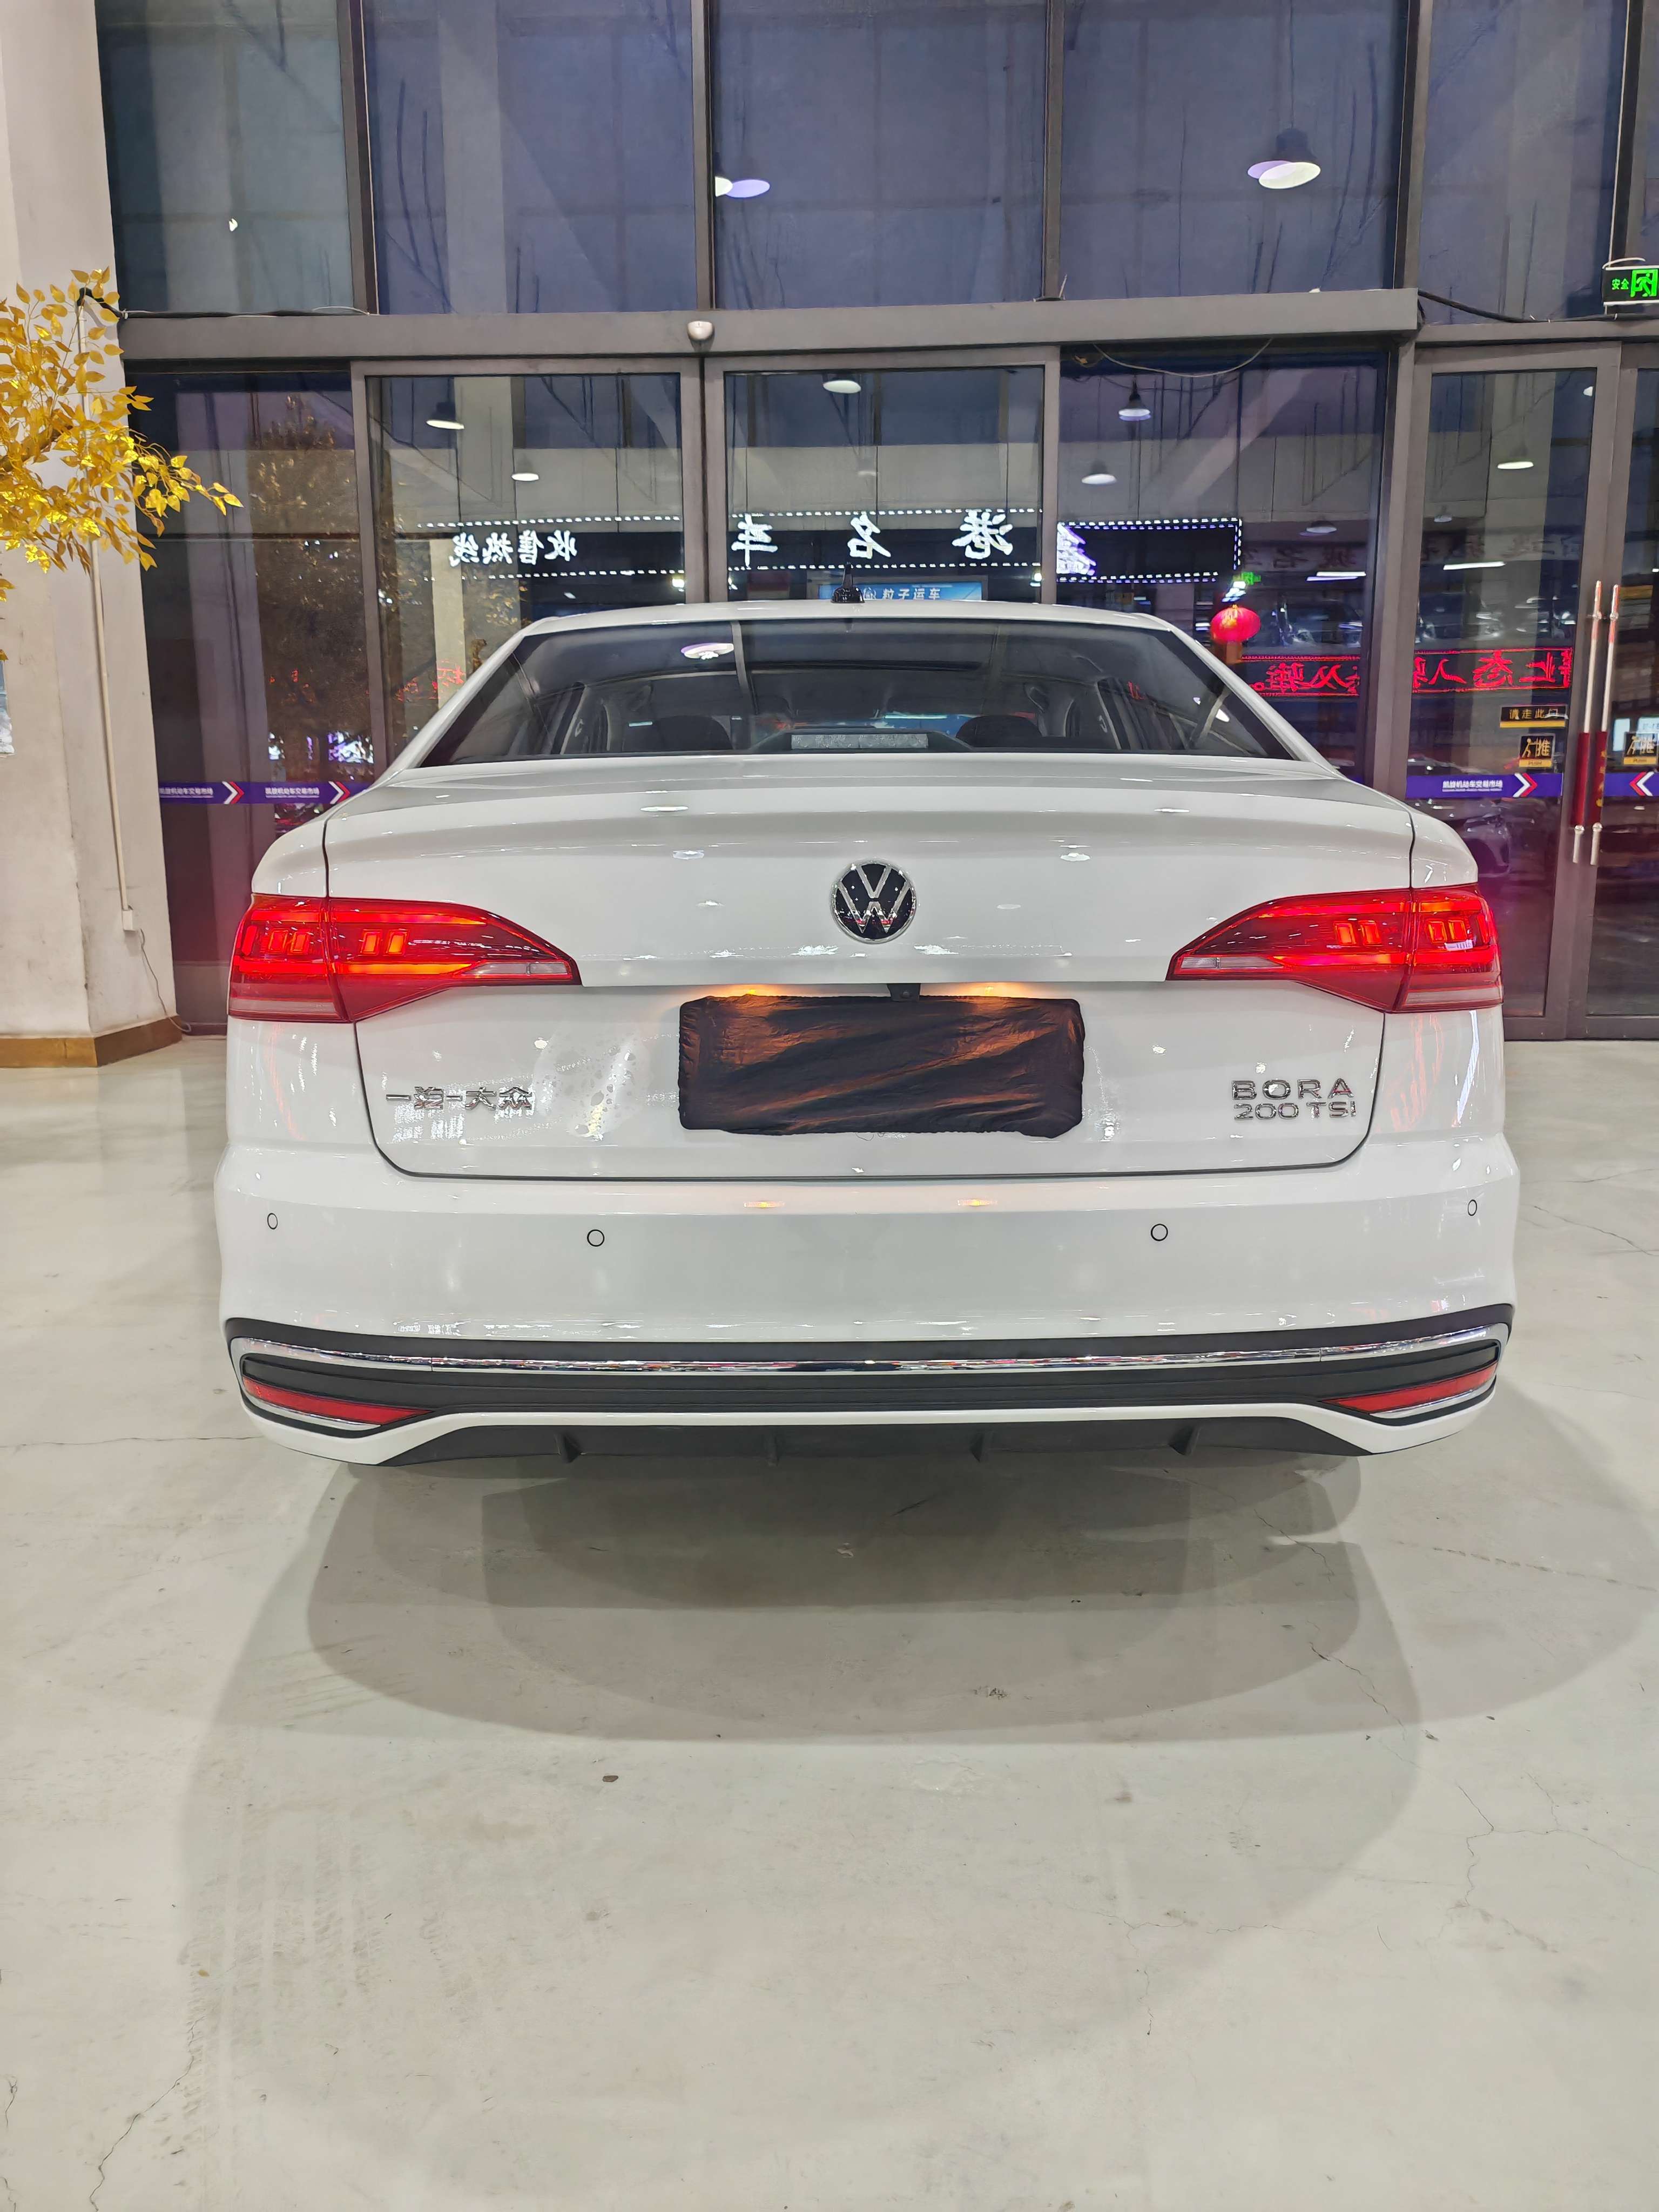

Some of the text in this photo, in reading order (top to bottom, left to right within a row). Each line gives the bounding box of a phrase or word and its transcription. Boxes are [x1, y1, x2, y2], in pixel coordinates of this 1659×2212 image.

[1611, 279, 1629, 290] 安全
[1508, 708, 1559, 720] 请走此门
[1535, 737, 1551, 757] 推
[1232, 1078, 1355, 1100] BORA
[1234, 1101, 1357, 1120] 200 TSI
